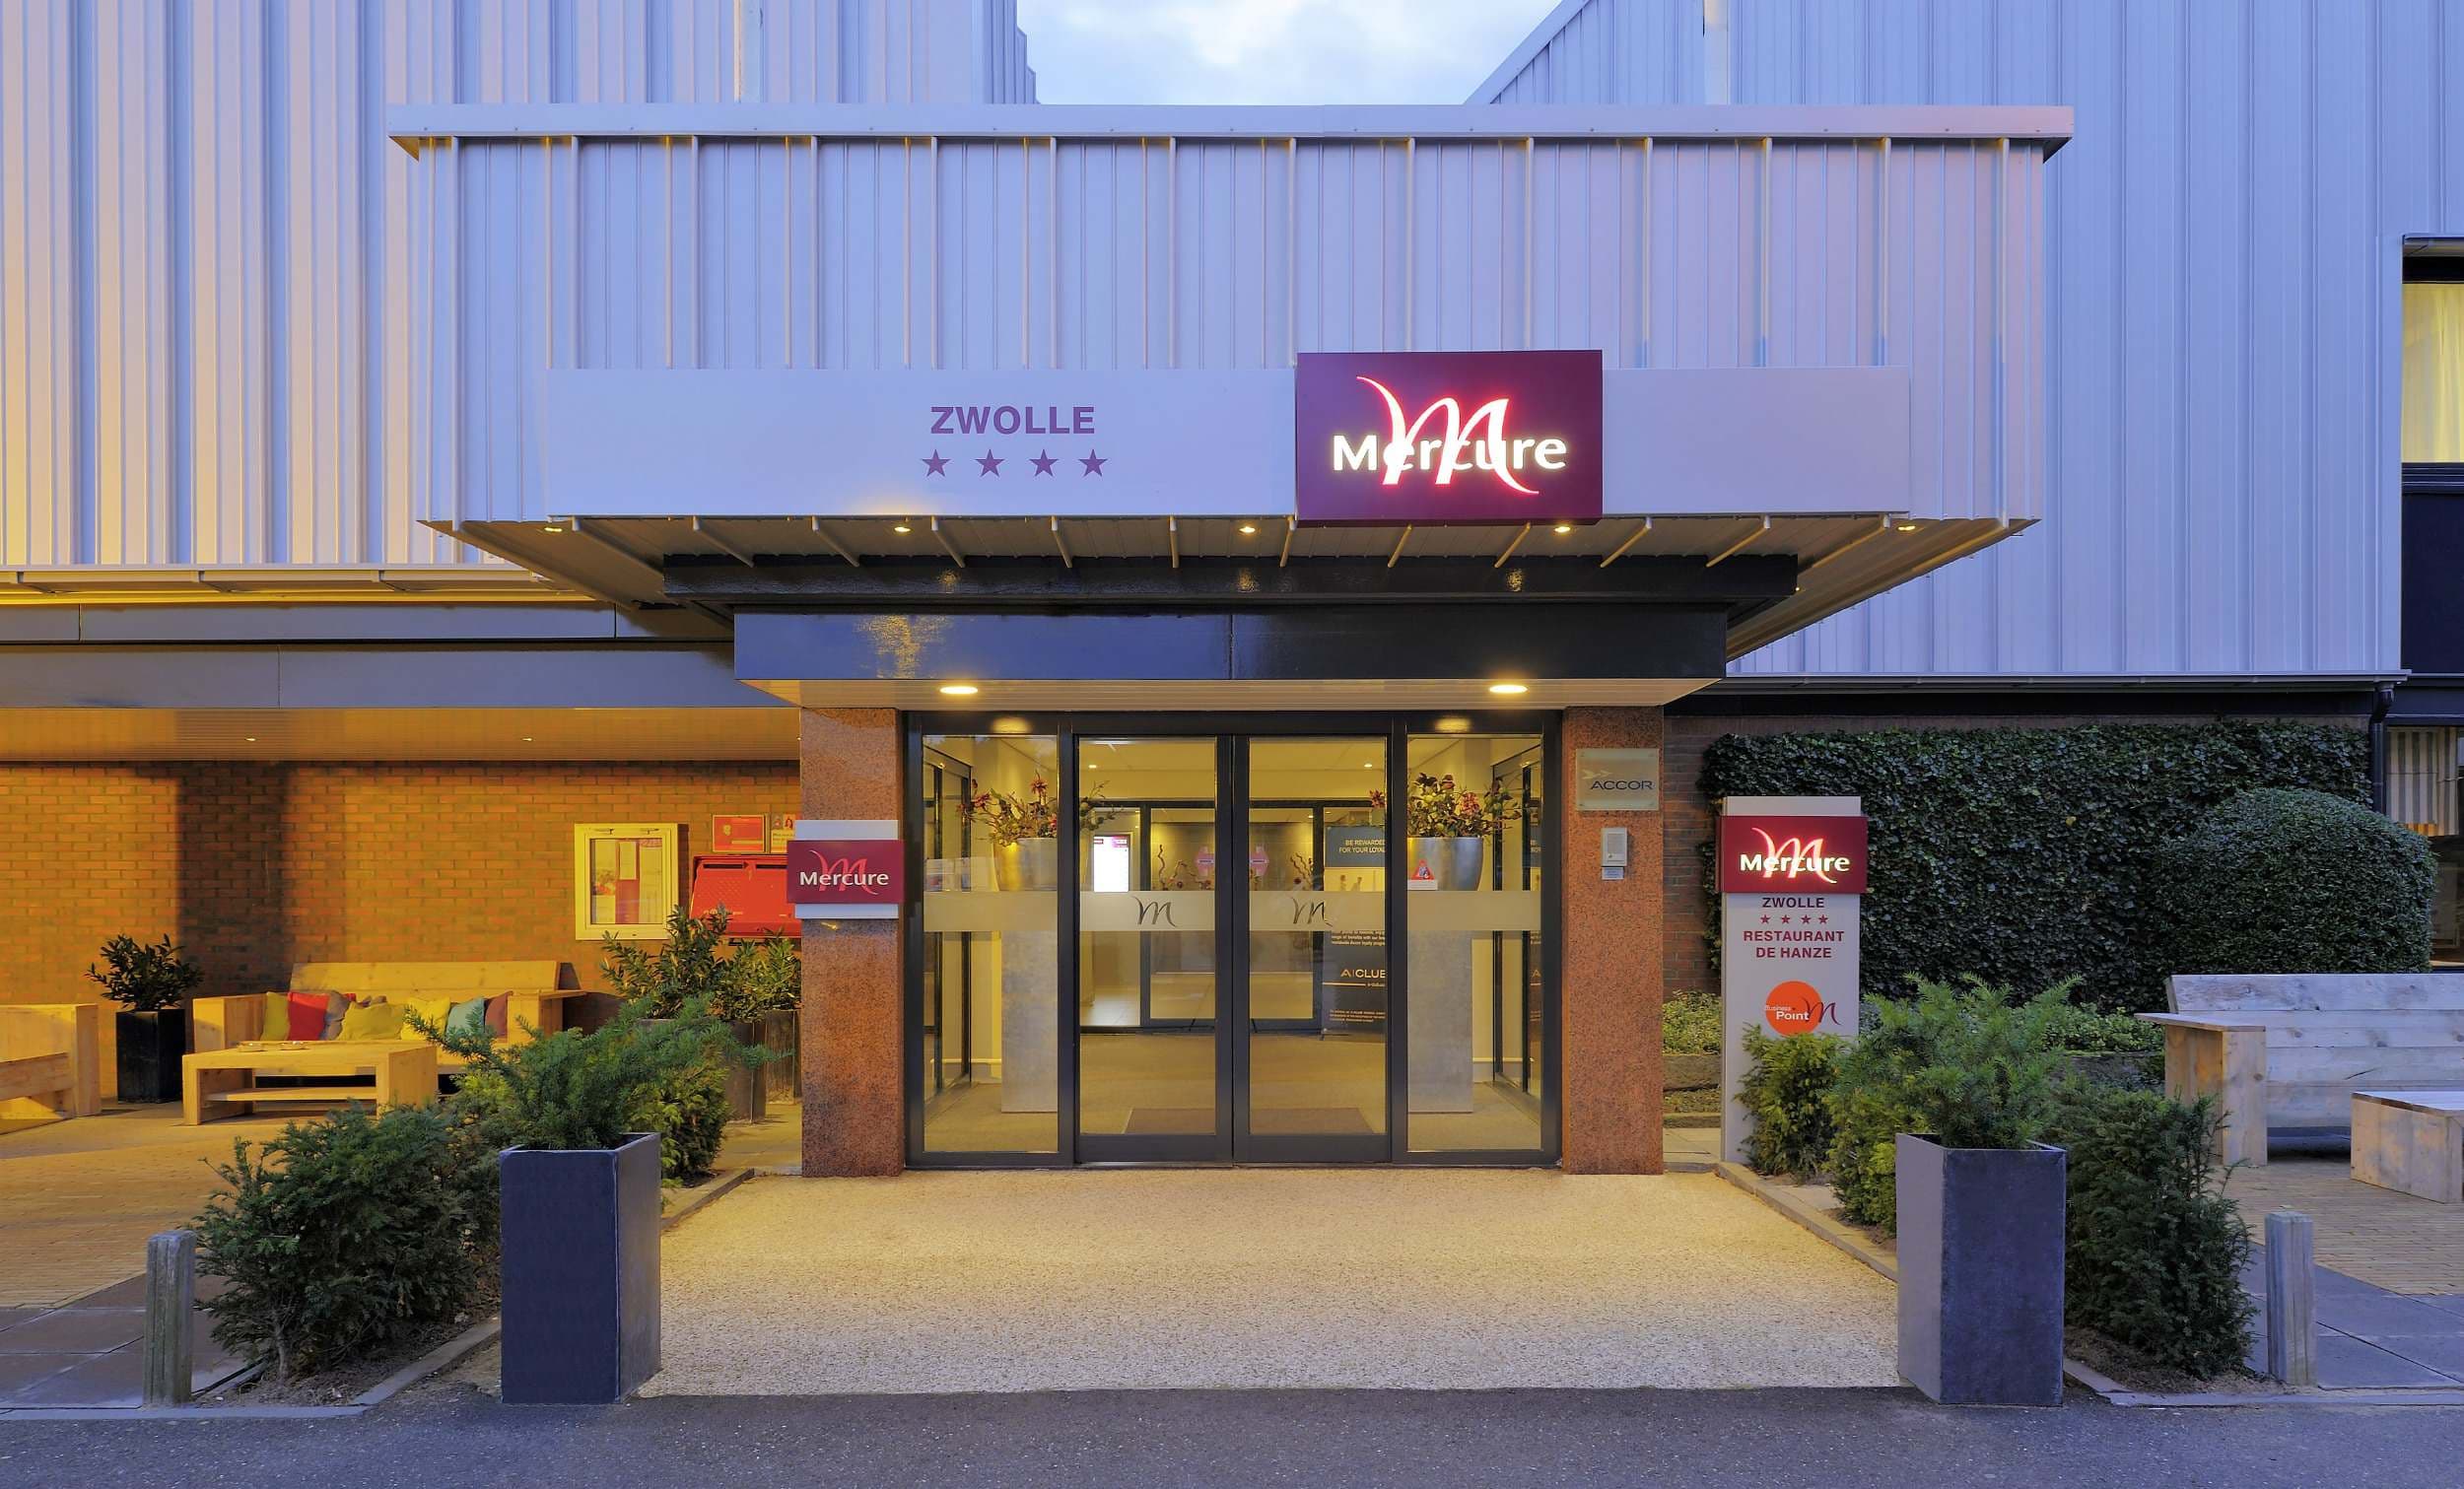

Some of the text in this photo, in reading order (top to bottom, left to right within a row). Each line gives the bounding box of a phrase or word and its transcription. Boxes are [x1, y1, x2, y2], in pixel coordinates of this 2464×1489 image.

[930, 406, 1095, 435] ZWOLLE
[1333, 435, 1567, 471] Mercure
[1591, 780, 1653, 790] ACCOR
[1740, 853, 1851, 872] Mercure
[799, 871, 890, 886] Mercure
[1762, 897, 1825, 909] ZWOLLE
[1743, 930, 1845, 942] RESTAURANT
[1755, 947, 1832, 959] DE HANZE
[1775, 1010, 1810, 1021] Point
